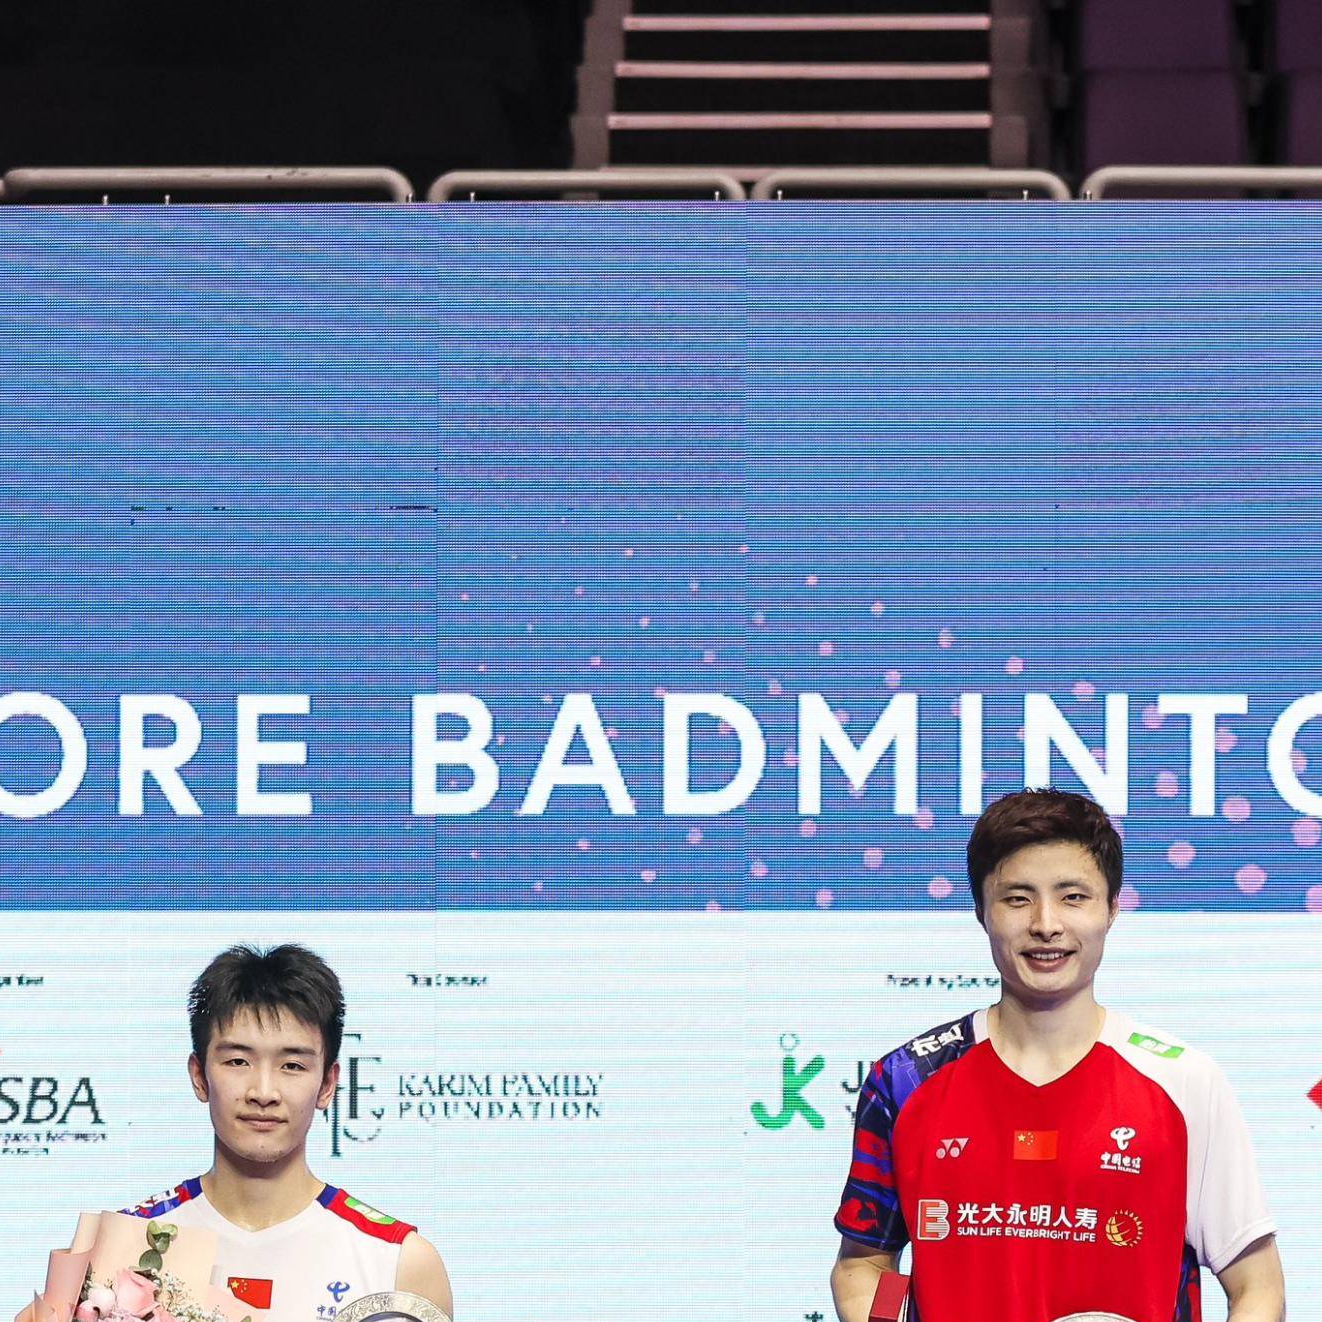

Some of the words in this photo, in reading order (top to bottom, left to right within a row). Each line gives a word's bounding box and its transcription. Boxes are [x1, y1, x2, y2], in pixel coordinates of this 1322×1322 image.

[399, 1074, 492, 1096] KARIM
[956, 1202, 1098, 1230] 光大永明人寿
[957, 1226, 978, 1236] SUN
[980, 1227, 1002, 1237] LIFE
[1005, 1227, 1070, 1240] EVERBRIGHT
[1073, 1231, 1096, 1242] LIFE
